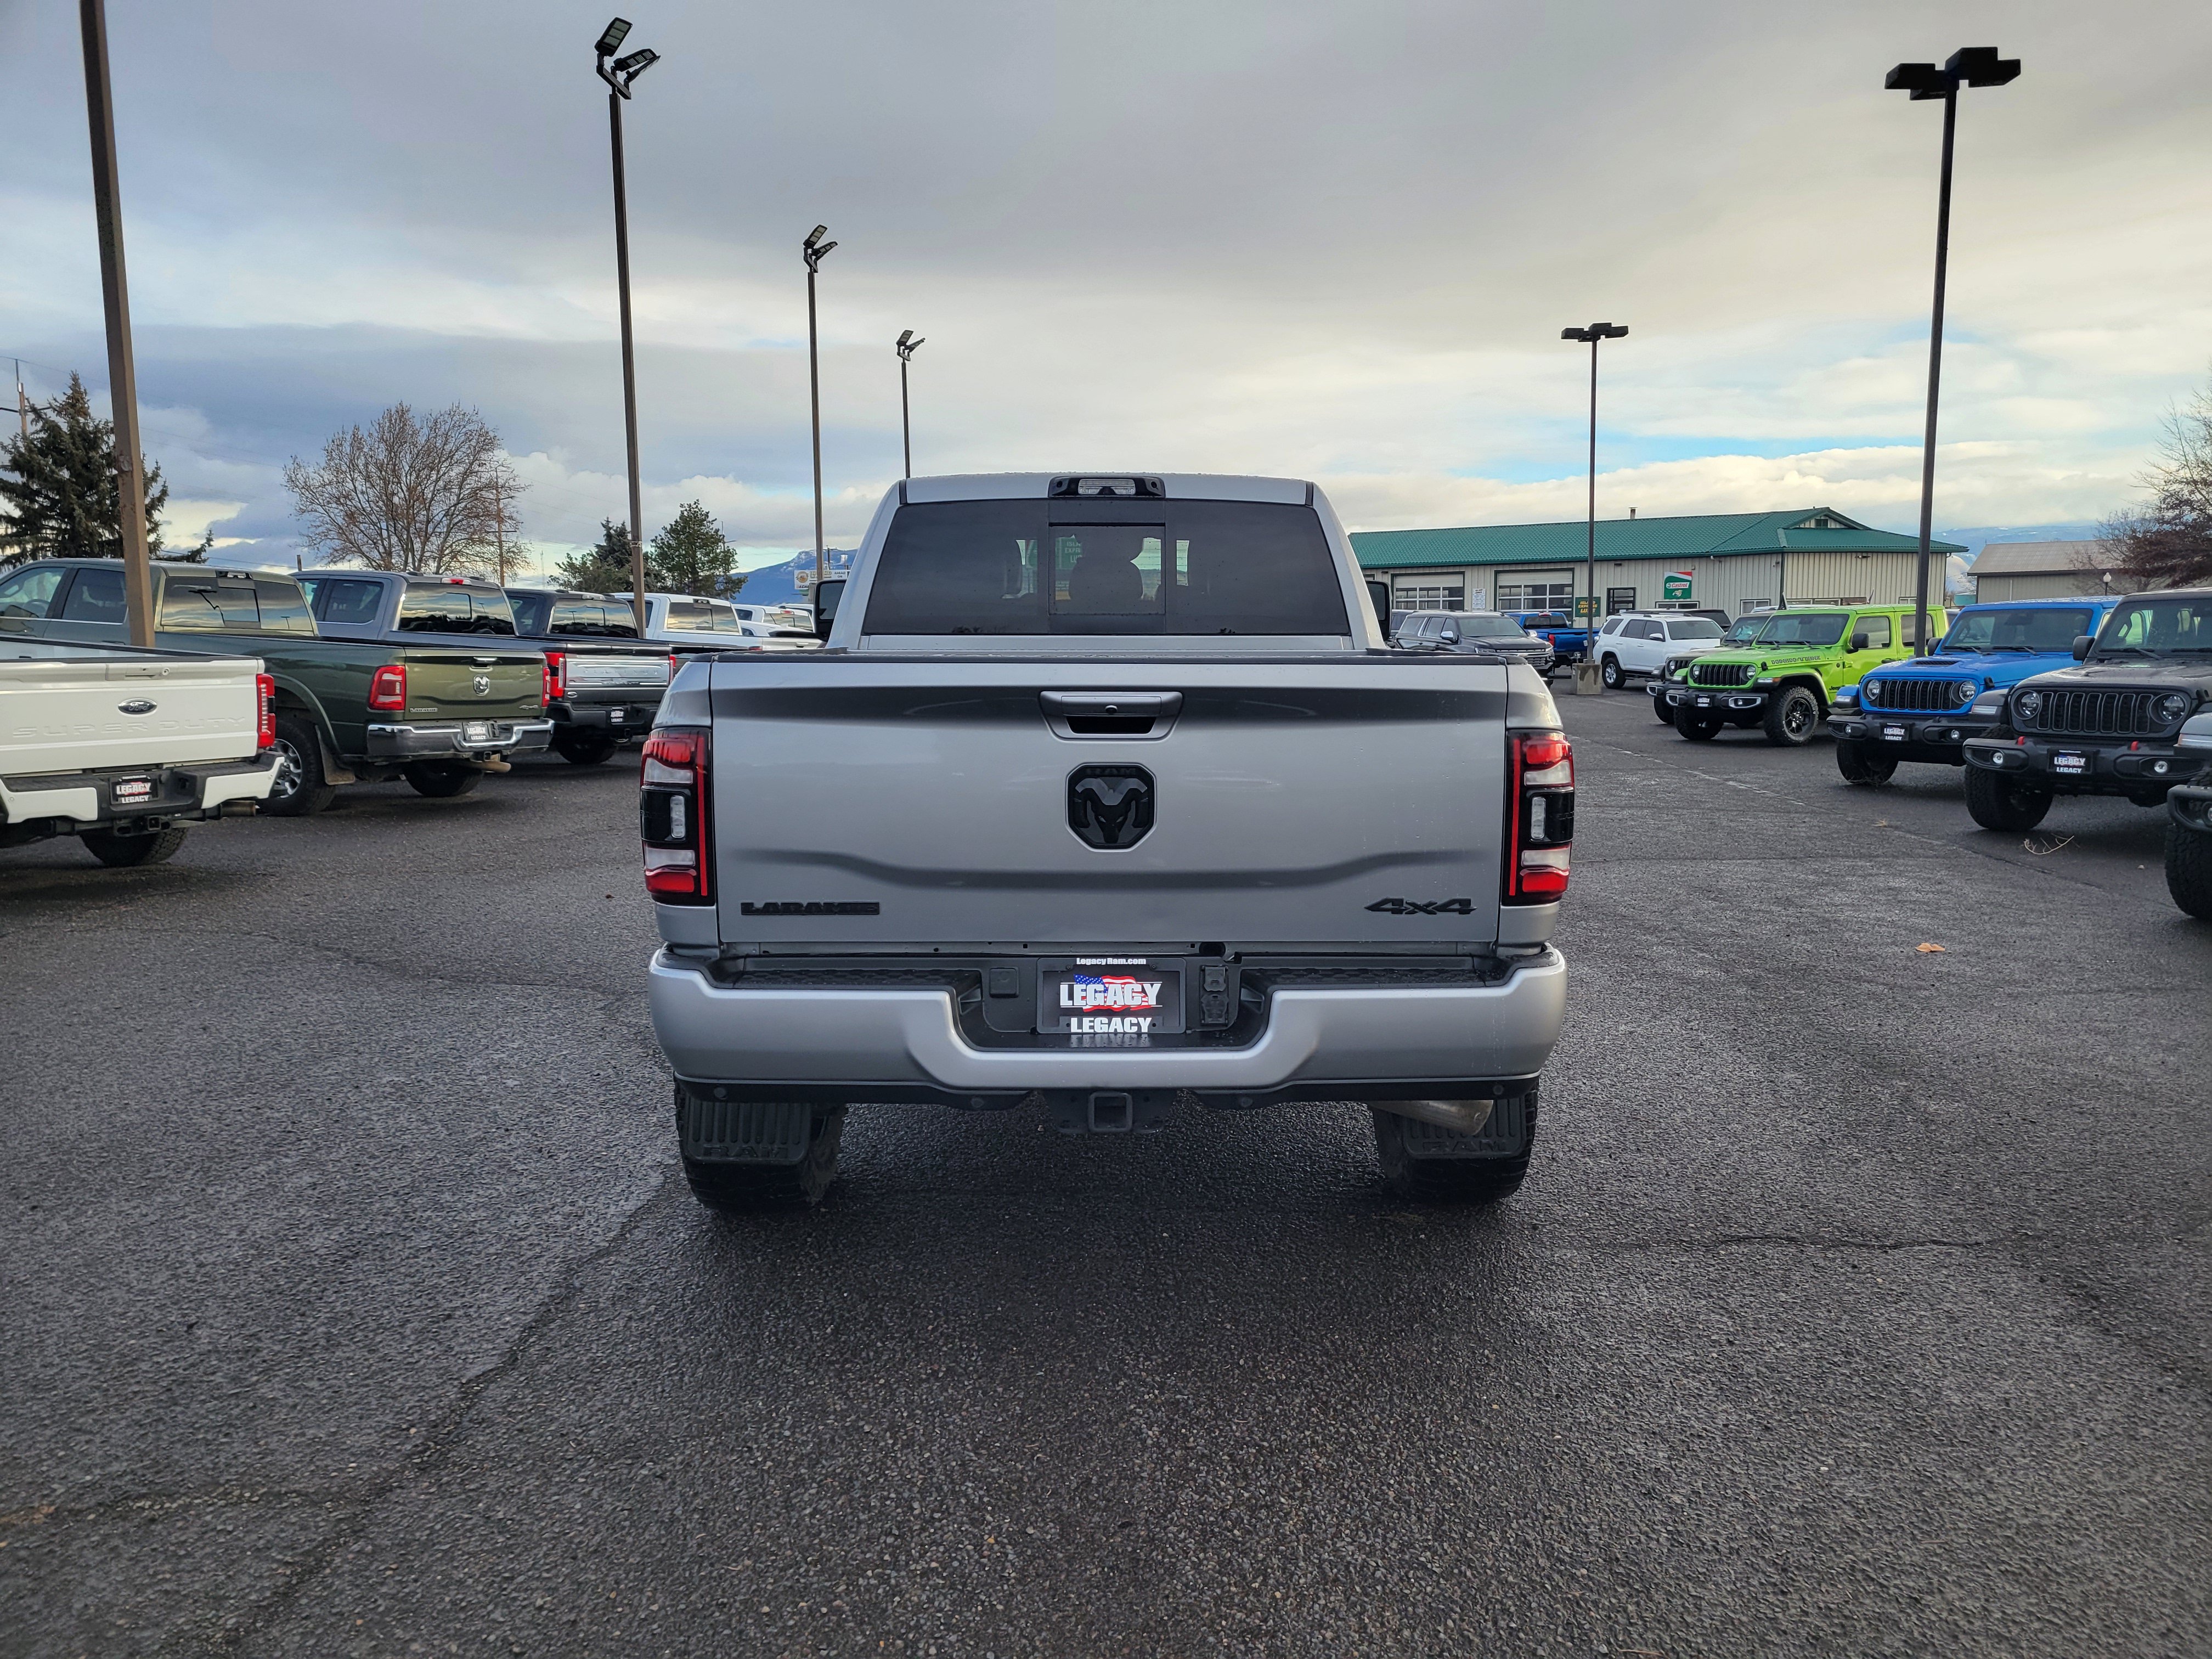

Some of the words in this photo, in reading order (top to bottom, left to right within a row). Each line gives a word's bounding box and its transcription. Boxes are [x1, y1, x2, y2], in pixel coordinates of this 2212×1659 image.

[128, 702, 149, 712] Ford
[13, 721, 148, 738] SUPER
[159, 716, 245, 731] DUTY
[2054, 757, 2086, 765] LEGACY
[116, 782, 151, 794] LEGACY
[121, 794, 149, 804] LEGACY
[1363, 897, 1478, 915] 4x4
[1060, 983, 1161, 1006] LEGACY
[1070, 1017, 1152, 1033] LEGACY
